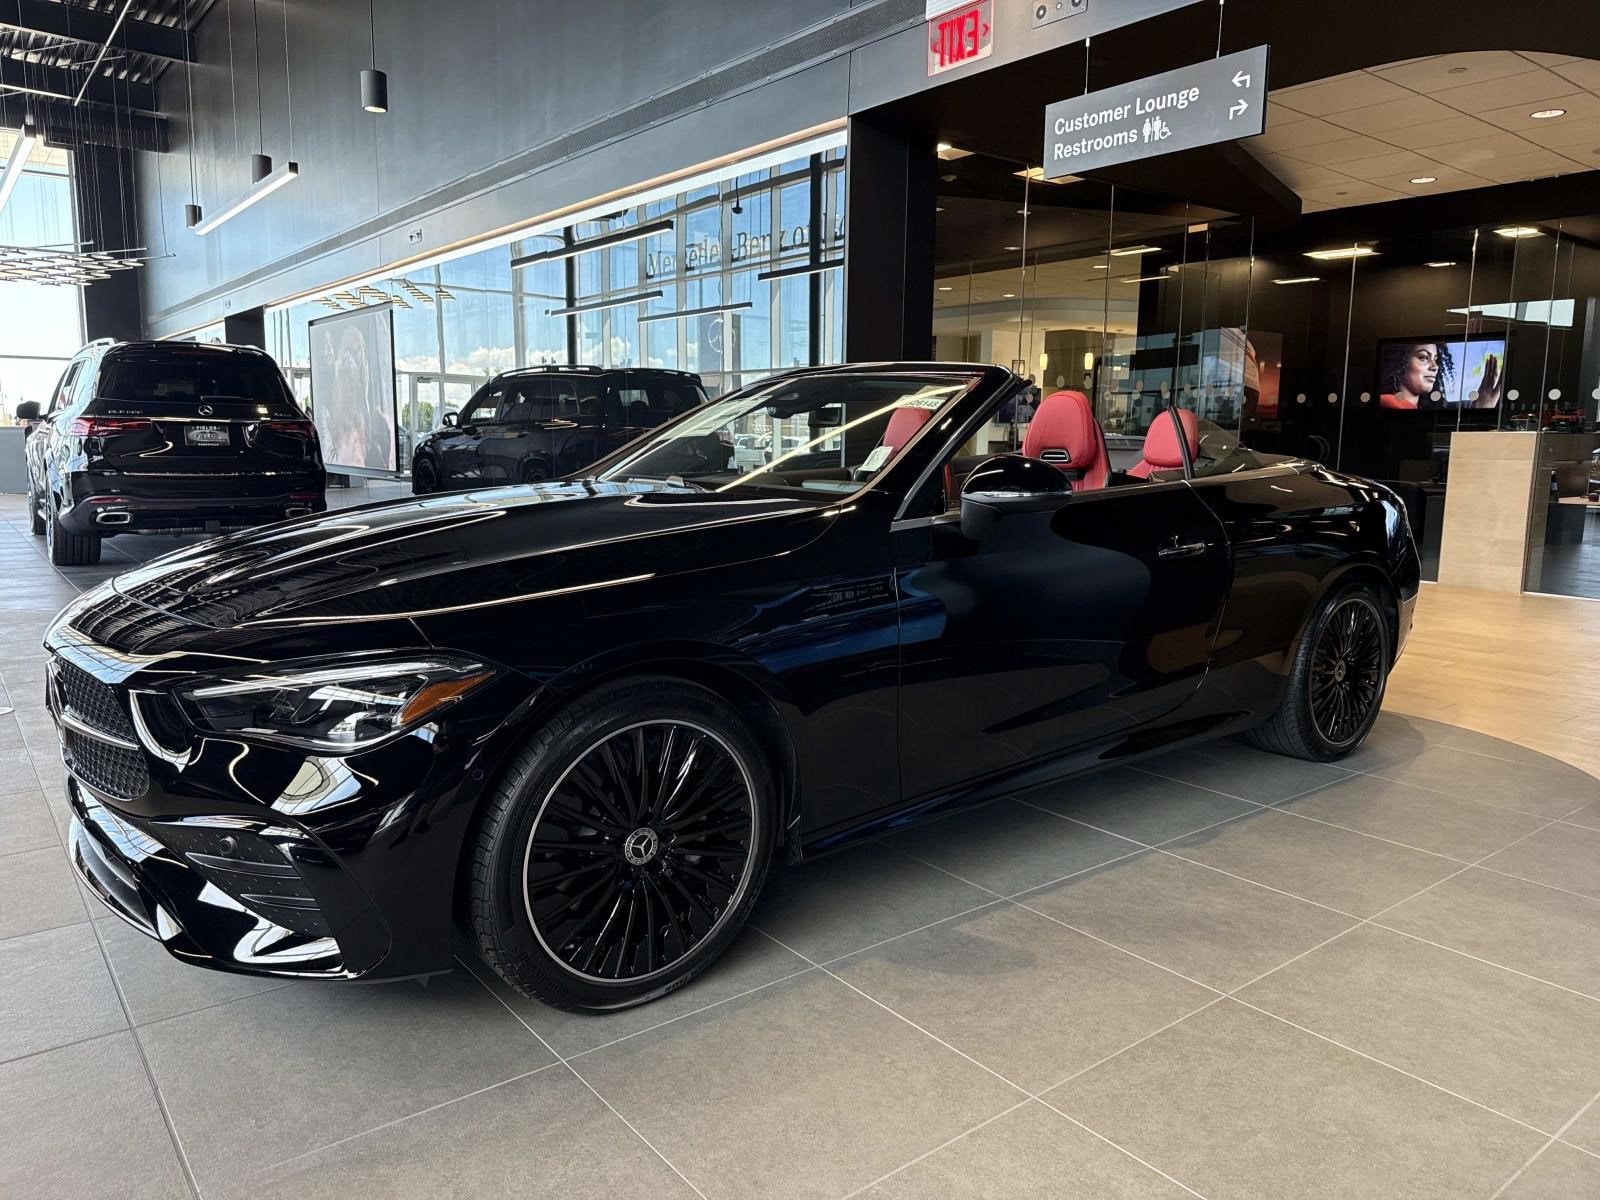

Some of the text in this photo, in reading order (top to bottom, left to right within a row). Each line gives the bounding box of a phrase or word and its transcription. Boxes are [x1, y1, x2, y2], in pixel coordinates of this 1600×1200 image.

[1054, 86, 1200, 135] Customer Lounge
[1053, 128, 1138, 161] Restrooms
